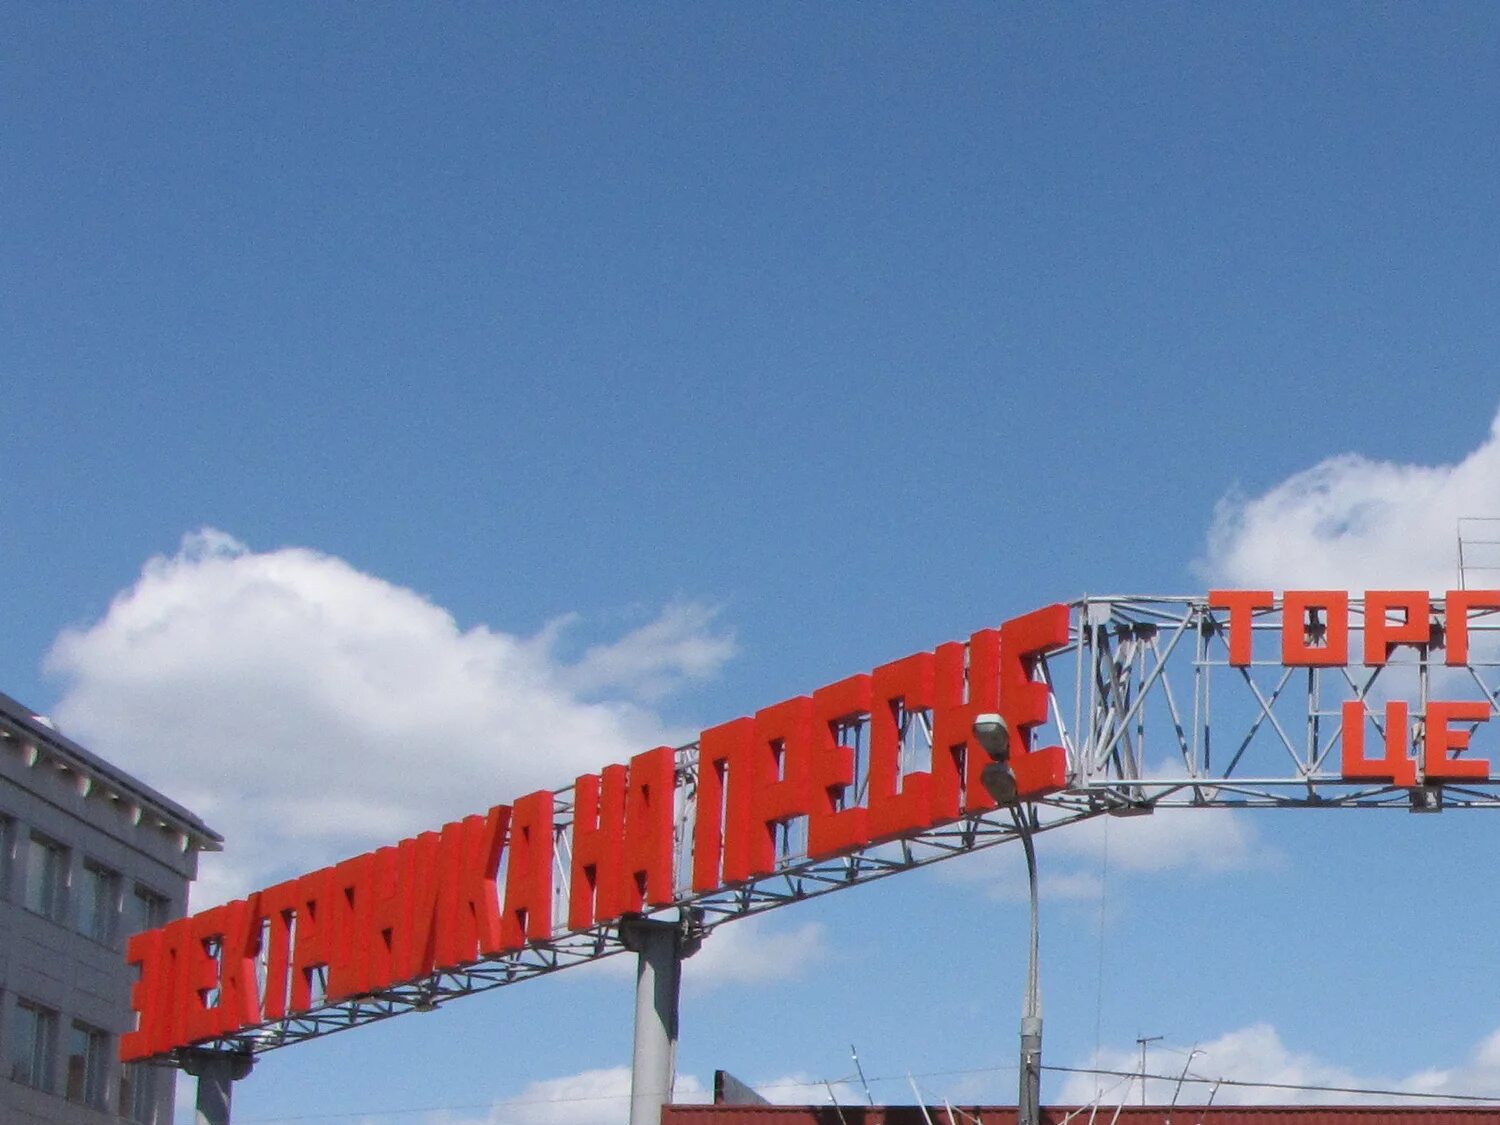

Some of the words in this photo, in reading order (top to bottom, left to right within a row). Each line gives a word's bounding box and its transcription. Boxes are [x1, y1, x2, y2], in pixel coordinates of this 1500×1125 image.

[119, 789, 554, 1062] ЭЛЕКТРОНИКА
[568, 745, 675, 931] НА
[692, 603, 1070, 892] ПРЕСНЕ
